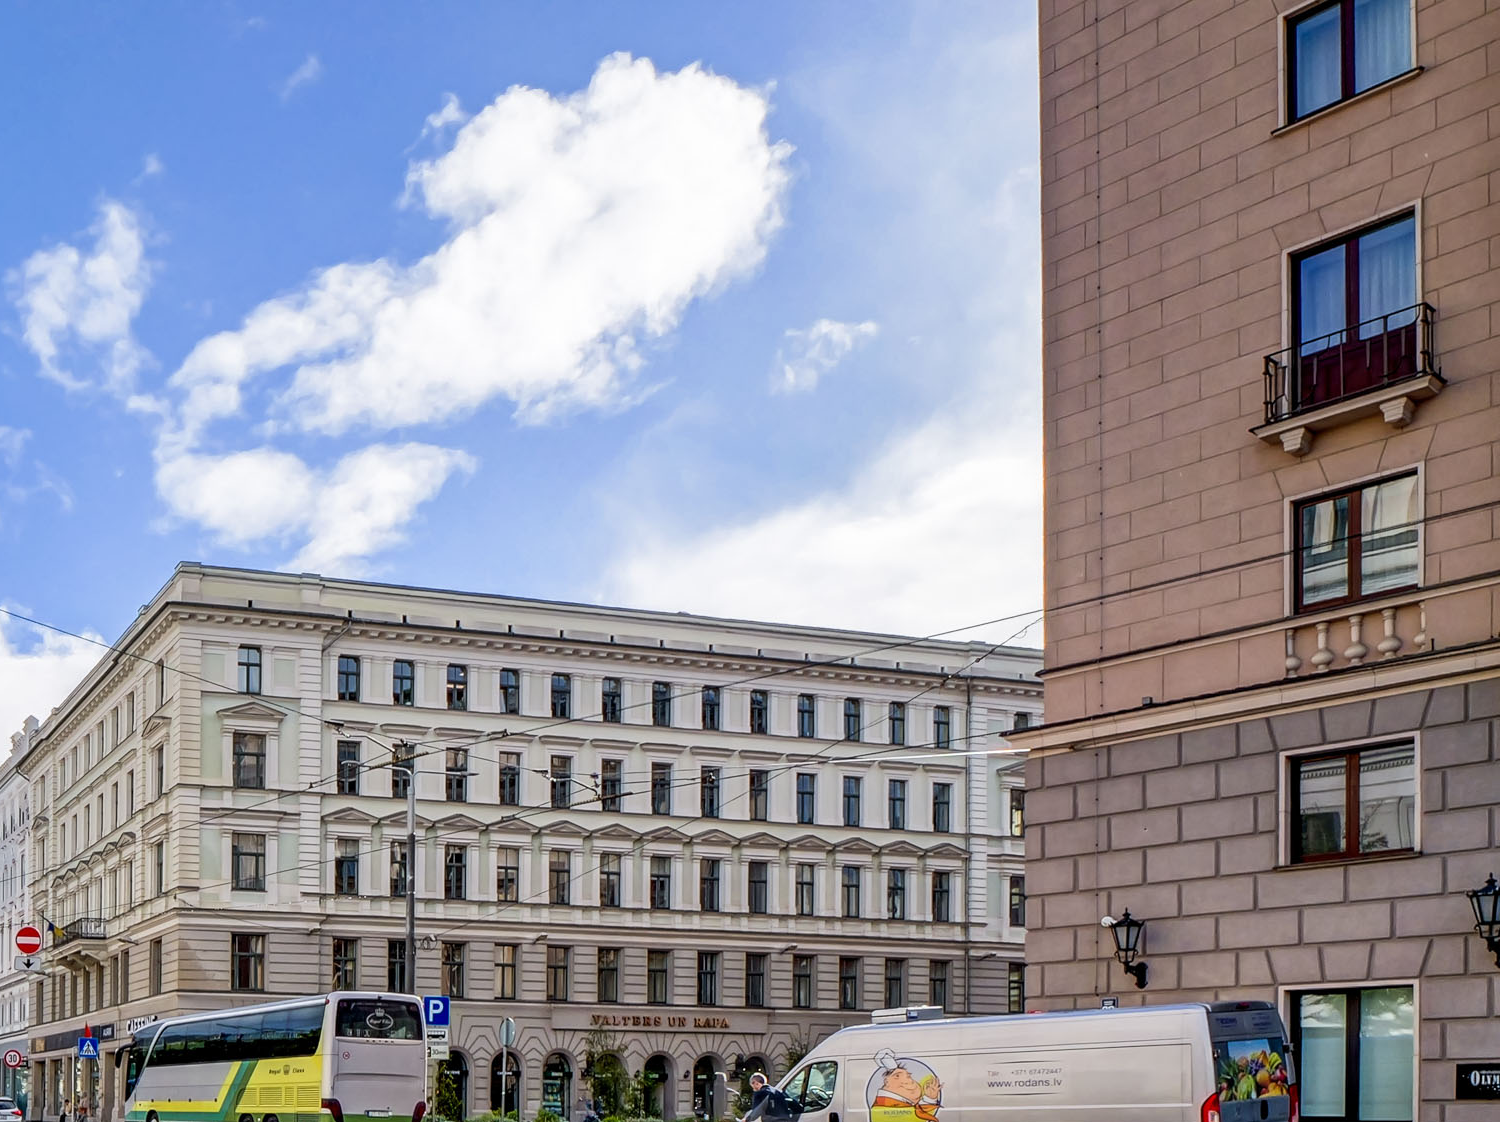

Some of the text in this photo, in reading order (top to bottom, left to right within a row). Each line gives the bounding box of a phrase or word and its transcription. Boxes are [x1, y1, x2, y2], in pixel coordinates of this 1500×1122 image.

[429, 1000, 444, 1022] P
[8, 1054, 18, 1063] 30
[987, 1078, 1062, 1088] www.rodans.lv
